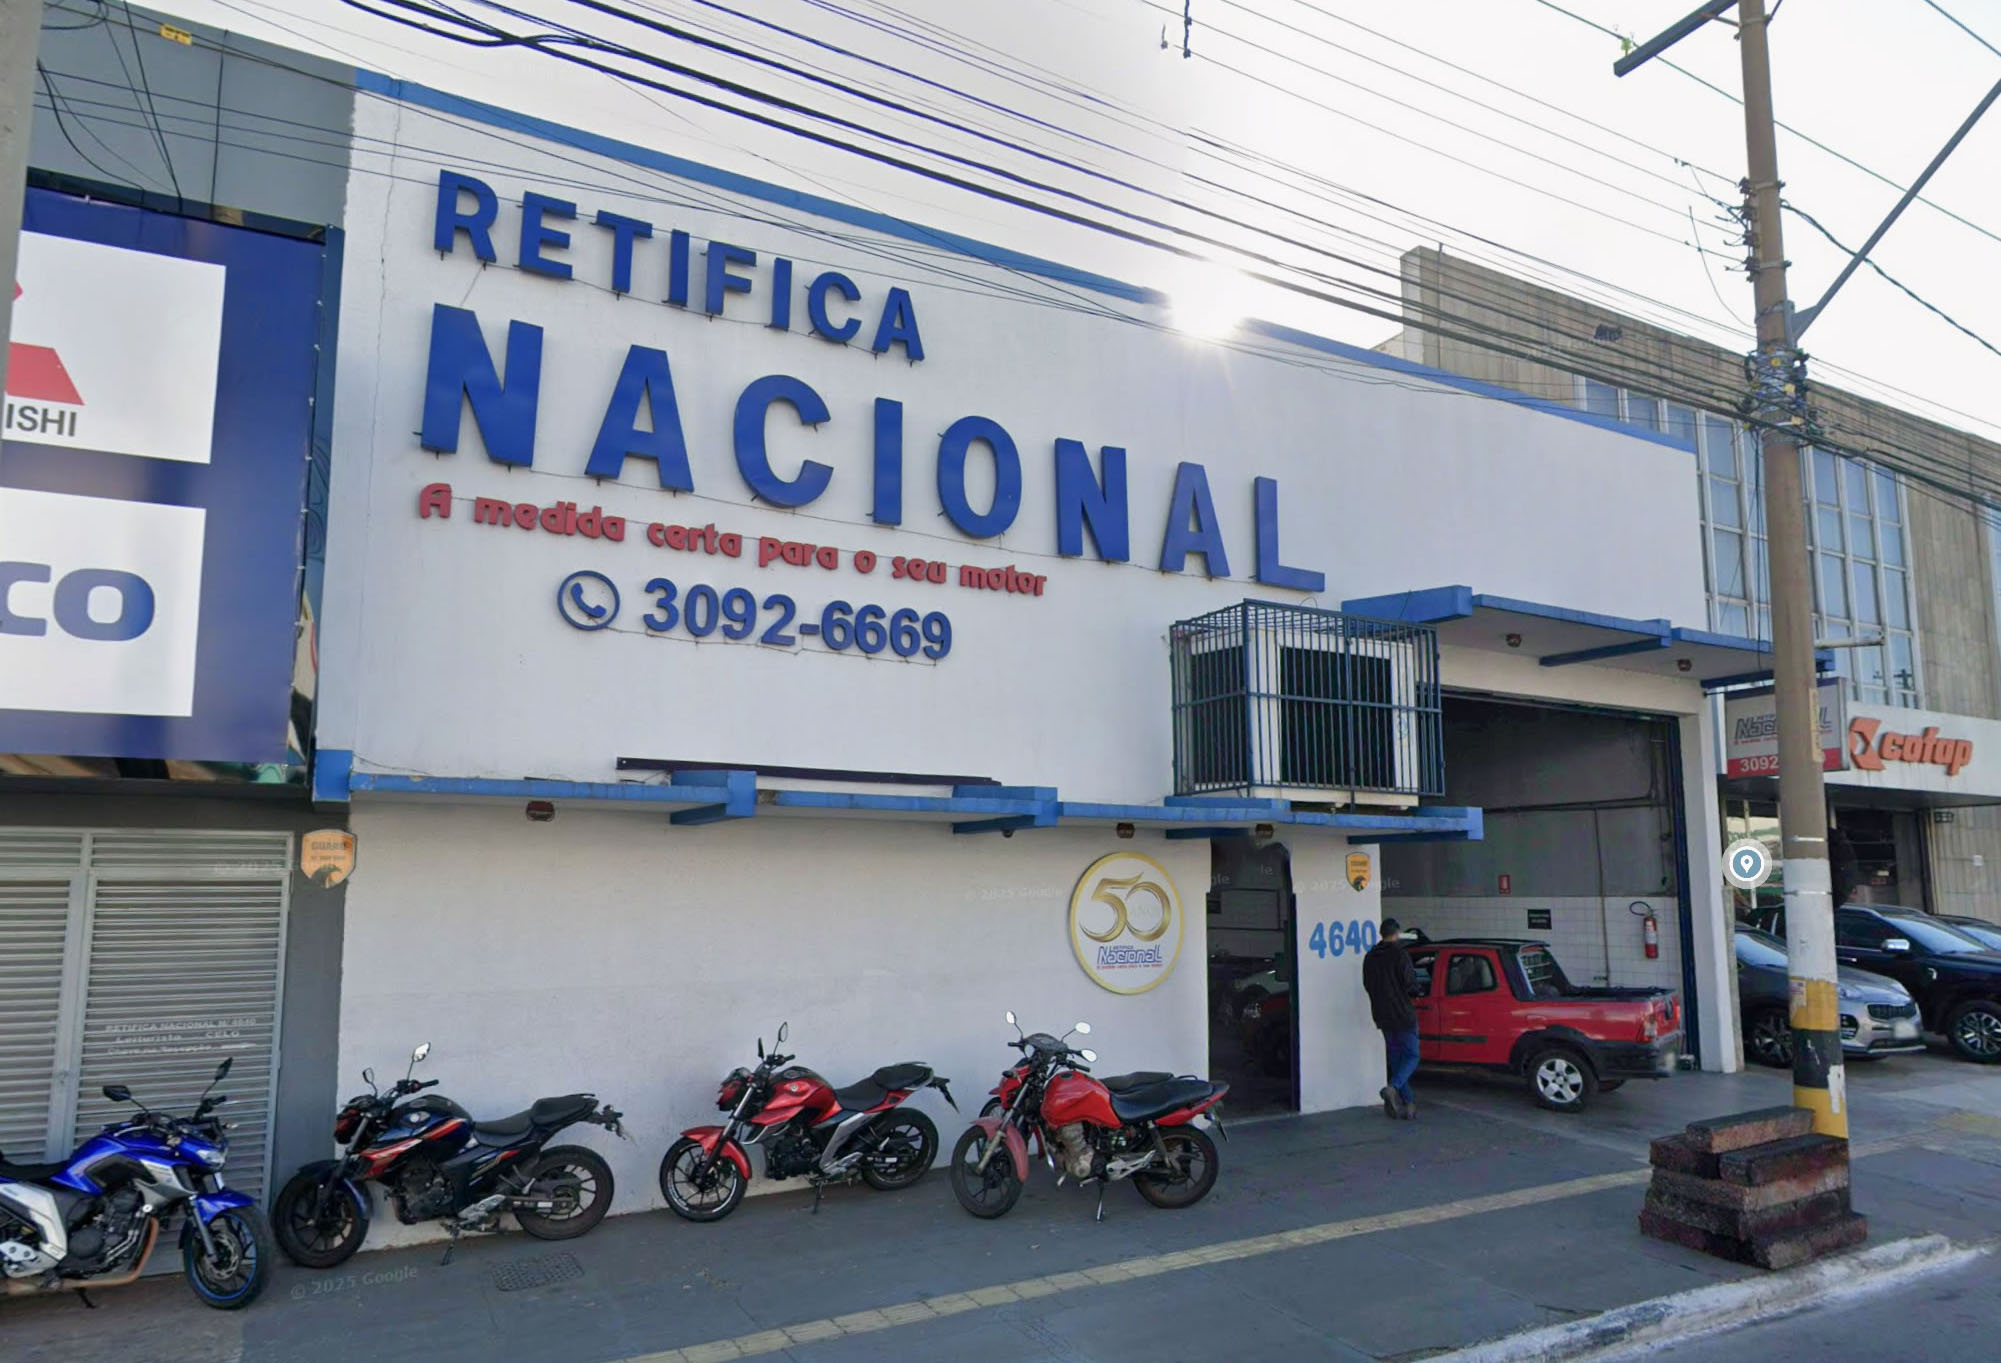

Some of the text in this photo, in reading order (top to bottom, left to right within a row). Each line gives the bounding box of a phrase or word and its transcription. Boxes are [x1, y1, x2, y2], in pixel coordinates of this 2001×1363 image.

[434, 169, 924, 362] RETIFICA
[418, 303, 1325, 593] NACIONAL
[420, 482, 1047, 597] A medida certa para o seu motor
[643, 577, 953, 661] 3092-6669
[1878, 726, 1973, 777] cofap
[1079, 871, 1171, 943] 50
[1308, 919, 1378, 959] 4640
